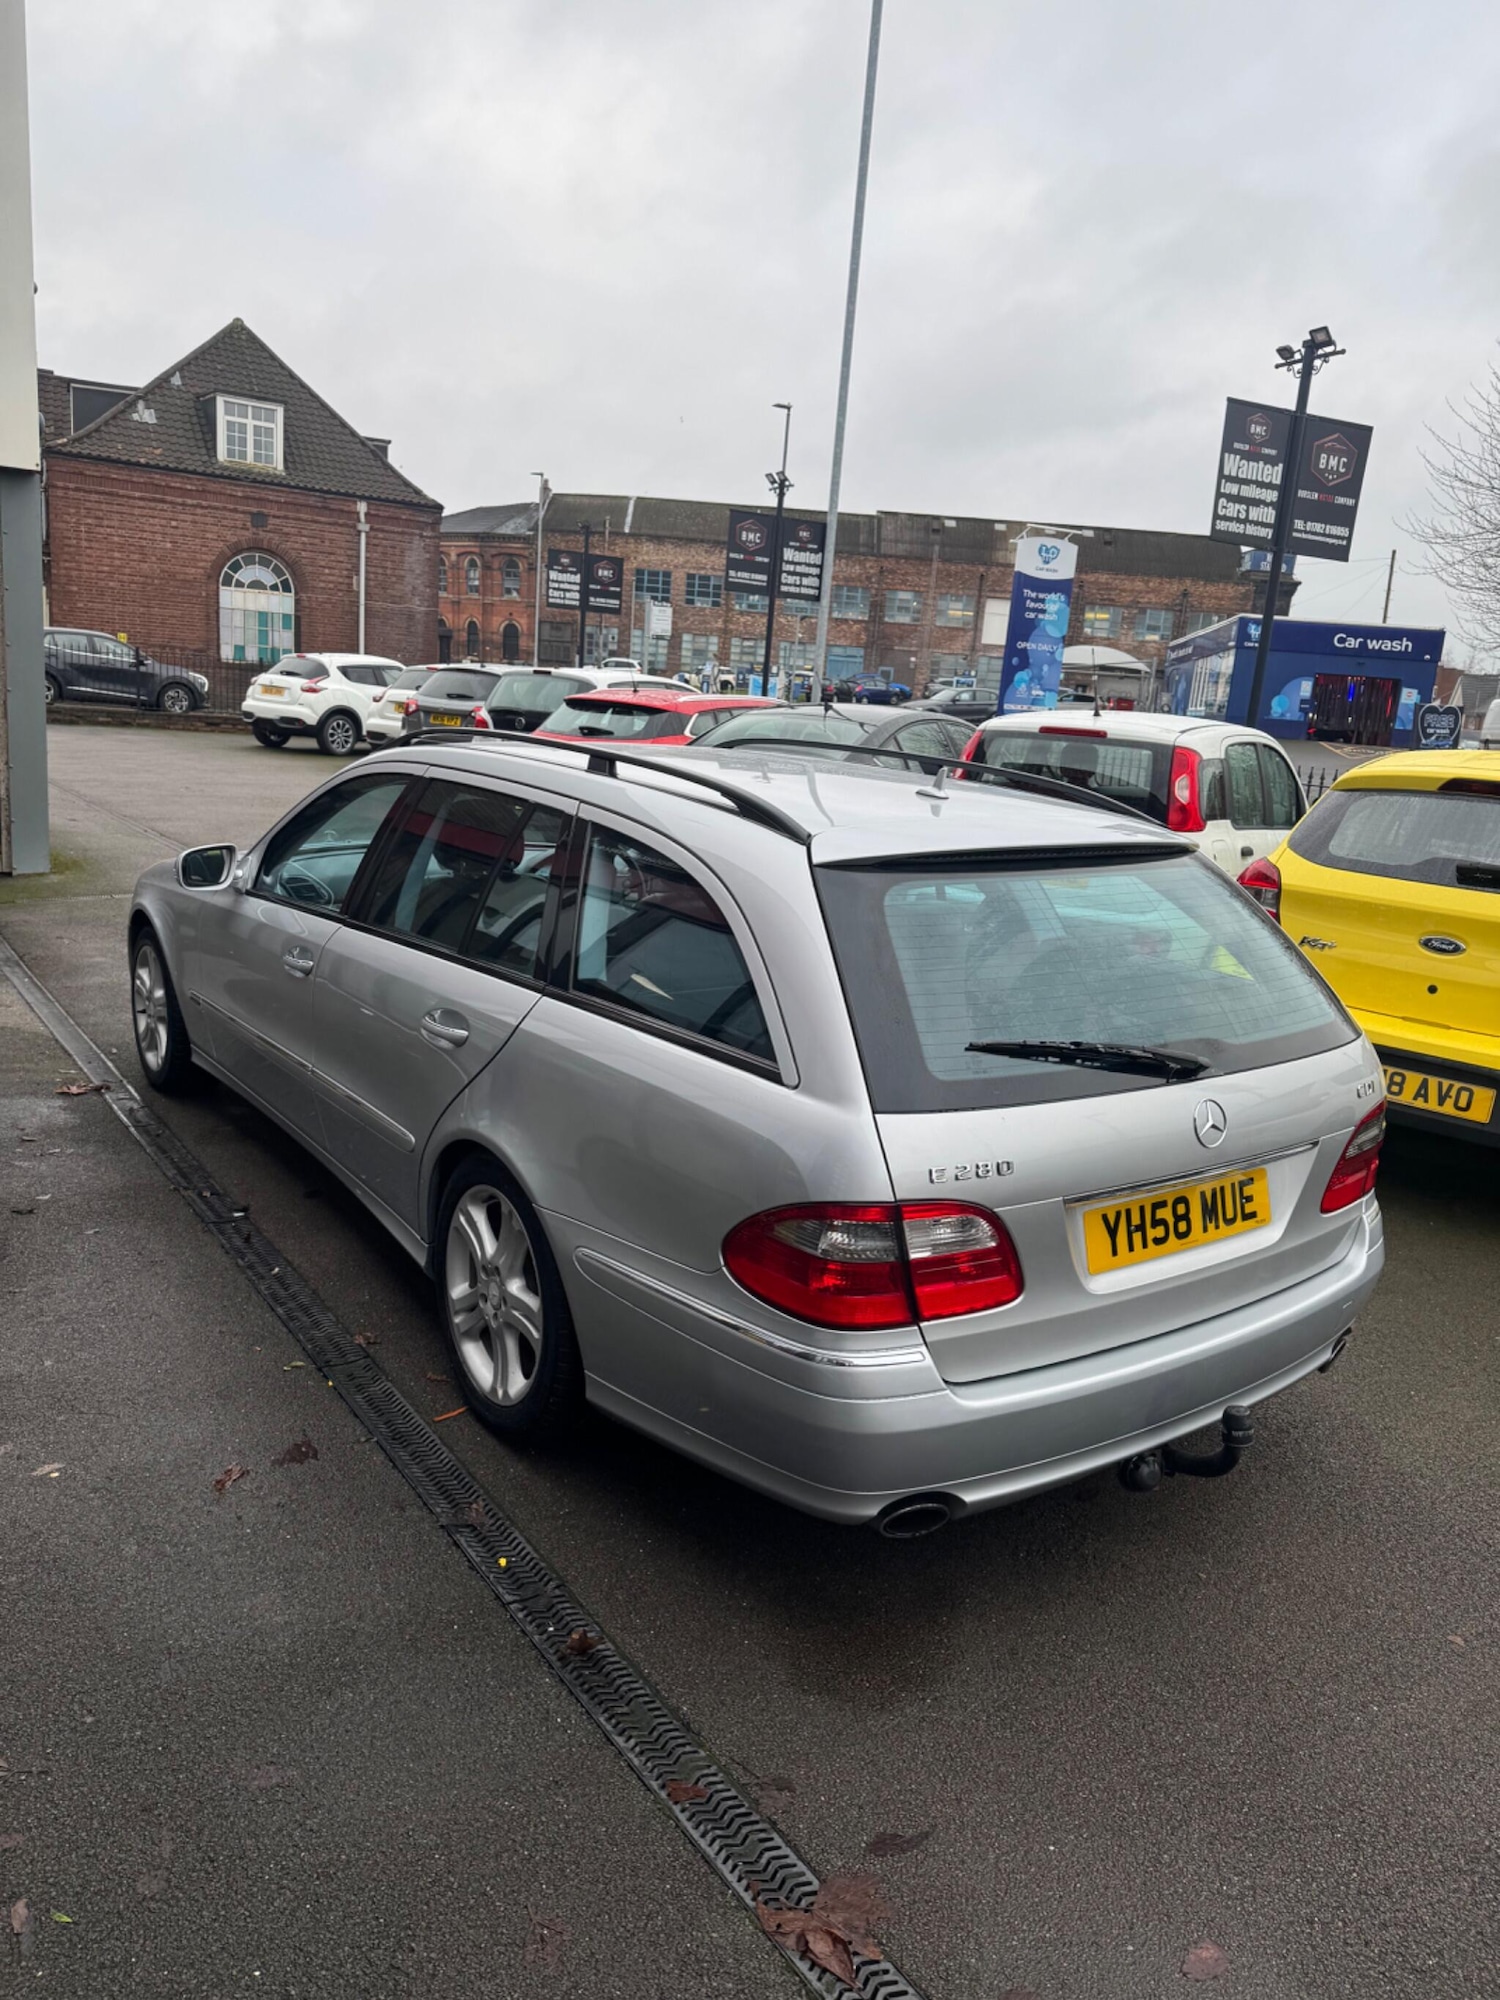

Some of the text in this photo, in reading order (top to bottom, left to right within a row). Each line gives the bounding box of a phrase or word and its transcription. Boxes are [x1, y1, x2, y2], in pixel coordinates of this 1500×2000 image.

[1250, 424, 1267, 435] BMC
[1223, 452, 1283, 485] Wanted
[1319, 453, 1348, 473] BMC
[1220, 479, 1278, 503] Low mileage
[1217, 497, 1276, 524] Cars with
[741, 530, 762, 543] BMC
[1215, 519, 1274, 540] service history
[783, 547, 823, 565] Wanted
[548, 569, 581, 584] Wanted
[782, 561, 820, 576] Low mileage
[781, 572, 800, 584] Cars
[801, 575, 820, 588] with
[548, 588, 564, 598] Cars
[1022, 588, 1065, 602] The world's
[1016, 641, 1058, 652] OPEN DAILY
[1333, 633, 1413, 653] Car wash
[1423, 713, 1456, 728] FREE
[1428, 939, 1455, 951] Ford
[1356, 1080, 1375, 1099] CDI
[1412, 1077, 1475, 1112] AVO
[928, 1159, 1015, 1185] E 280
[1101, 1177, 1258, 1257] YH58 MUE
